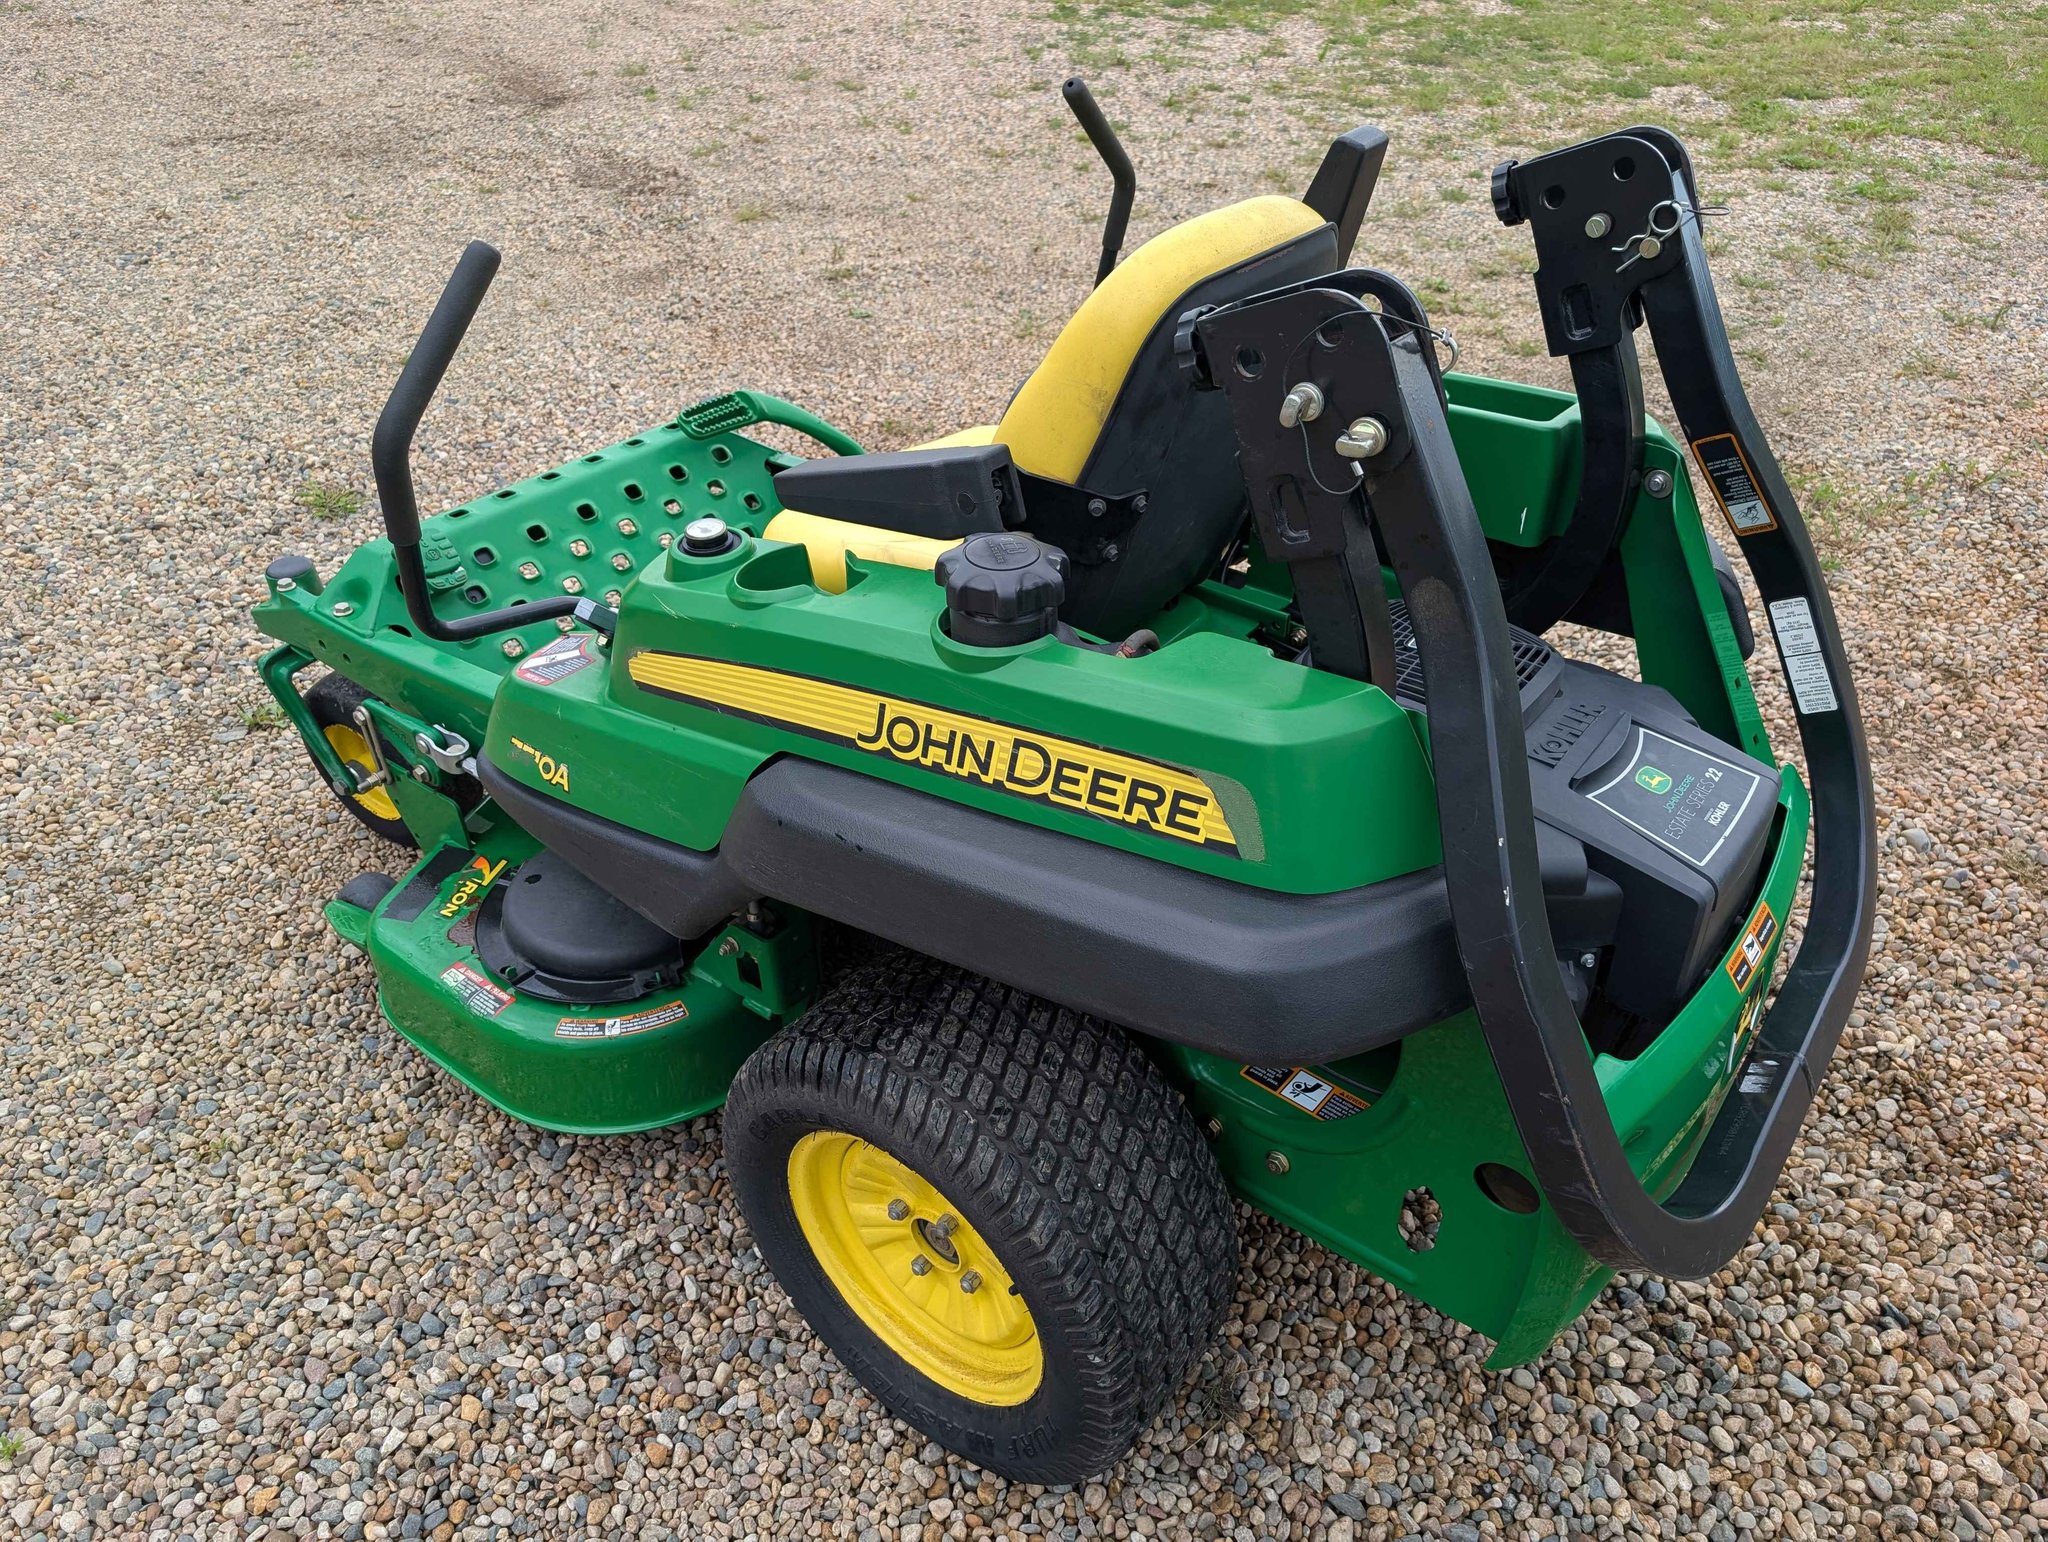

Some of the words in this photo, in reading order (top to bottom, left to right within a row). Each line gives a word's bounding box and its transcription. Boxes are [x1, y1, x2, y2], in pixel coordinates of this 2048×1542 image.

[1528, 705, 1607, 768] KOHLER
[854, 702, 997, 783] JOHN
[1005, 739, 1209, 838] DEERE
[1662, 792, 1681, 813] JOHN
[1673, 772, 1695, 798] DEERE
[1664, 804, 1696, 841] ESTATE
[1685, 775, 1715, 810] SERIES
[1703, 764, 1723, 783] 22
[1707, 799, 1731, 827] KOHLER
[463, 968, 483, 983] DANGER
[490, 985, 511, 1001] PELIGRO
